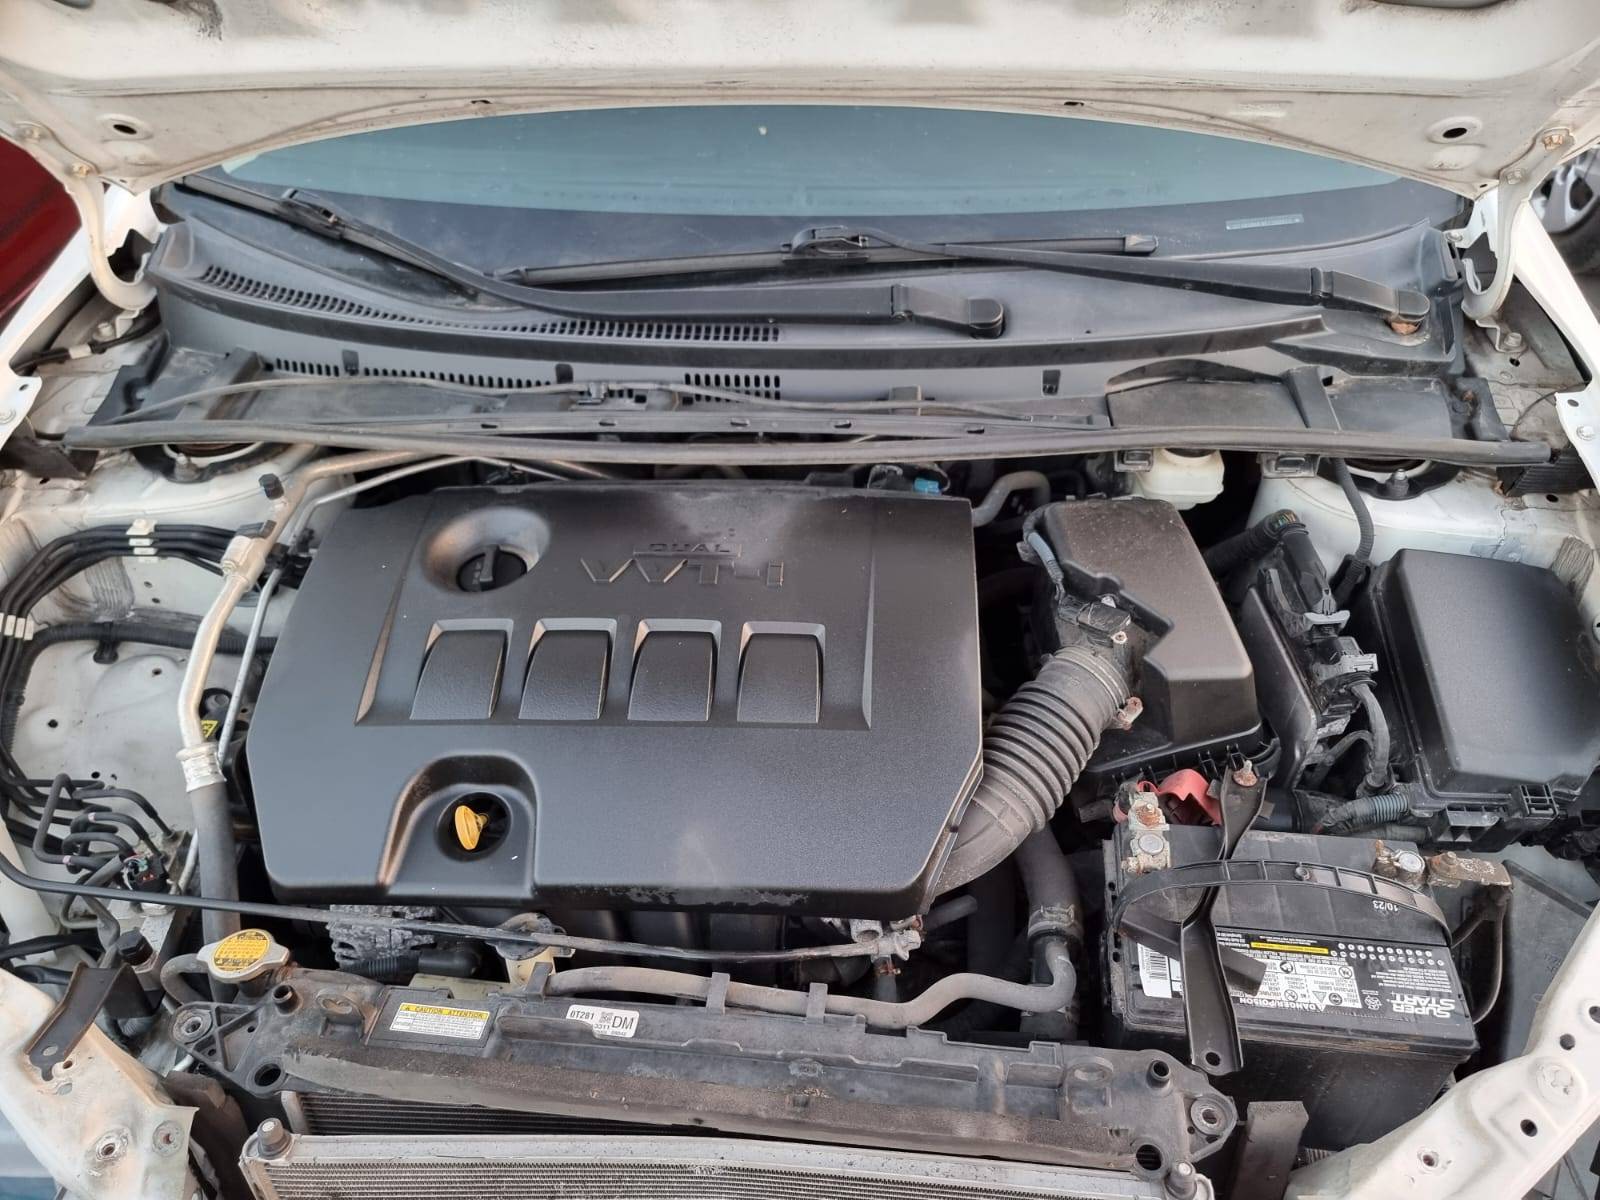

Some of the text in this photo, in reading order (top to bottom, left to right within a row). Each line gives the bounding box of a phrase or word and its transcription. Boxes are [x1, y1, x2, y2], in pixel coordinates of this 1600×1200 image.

[1372, 900, 1399, 912] 10/23
[1390, 994, 1456, 1010] START
[1392, 1003, 1452, 1019] SUPER
[612, 1015, 634, 1030] DM
